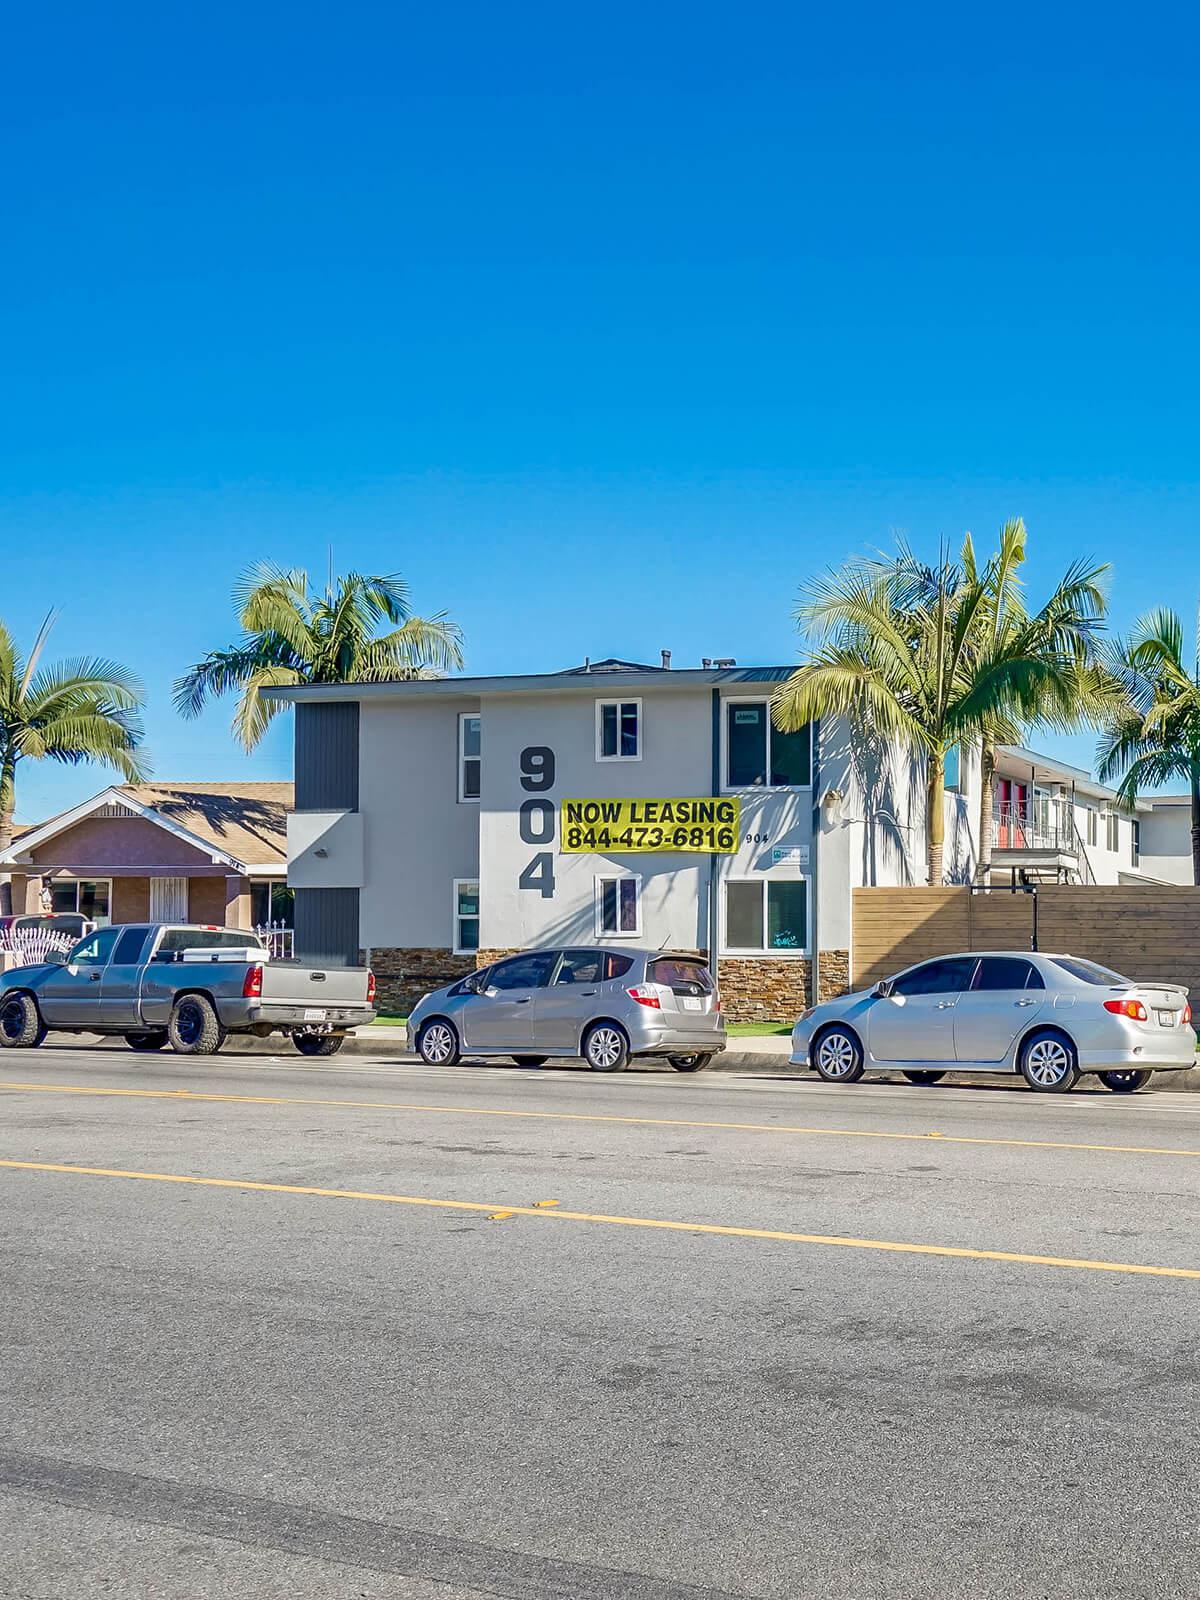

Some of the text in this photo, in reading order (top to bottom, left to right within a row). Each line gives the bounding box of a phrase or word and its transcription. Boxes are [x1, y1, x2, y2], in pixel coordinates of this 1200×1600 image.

[518, 746, 555, 898] 904
[567, 802, 734, 823] NOW LEASING
[567, 827, 734, 848] 844-473-6816
[746, 833, 769, 843] 904
